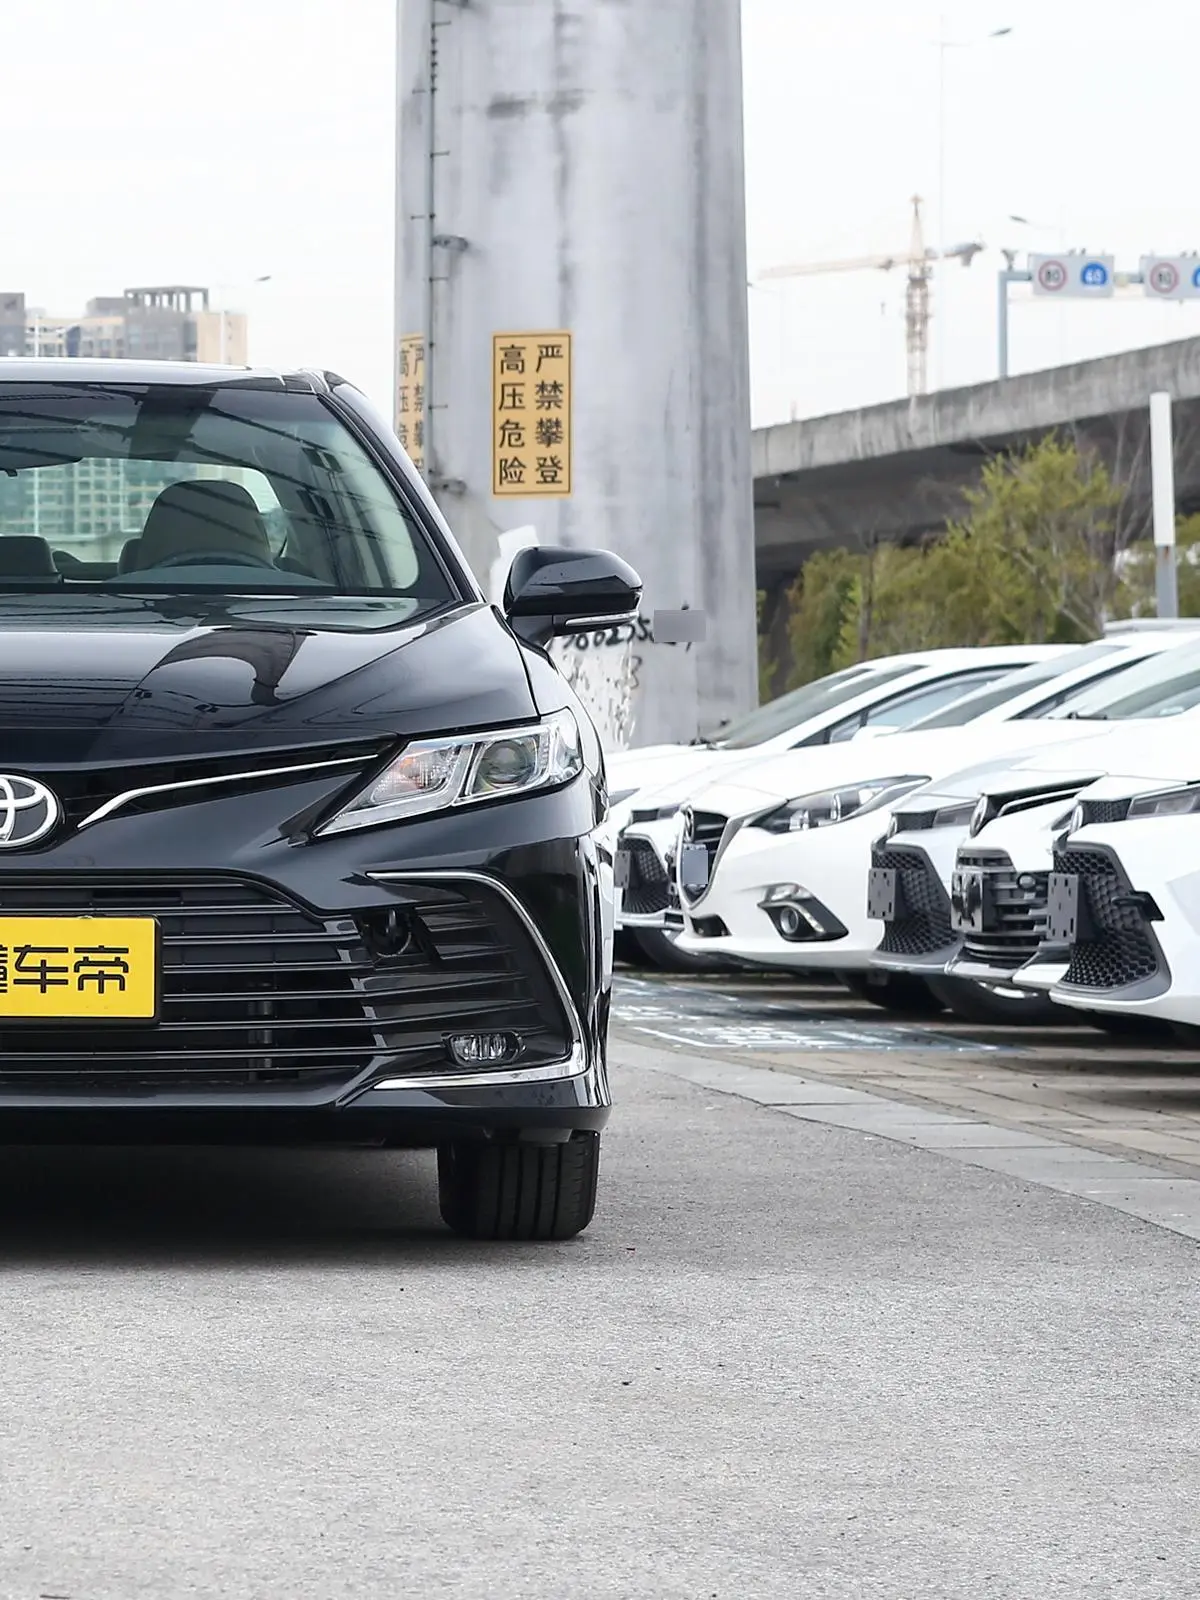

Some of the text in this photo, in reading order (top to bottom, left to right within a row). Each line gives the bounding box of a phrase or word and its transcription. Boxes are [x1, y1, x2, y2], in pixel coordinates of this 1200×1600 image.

[498, 344, 527, 486] 高压危险
[535, 344, 564, 485] 严禁攀登
